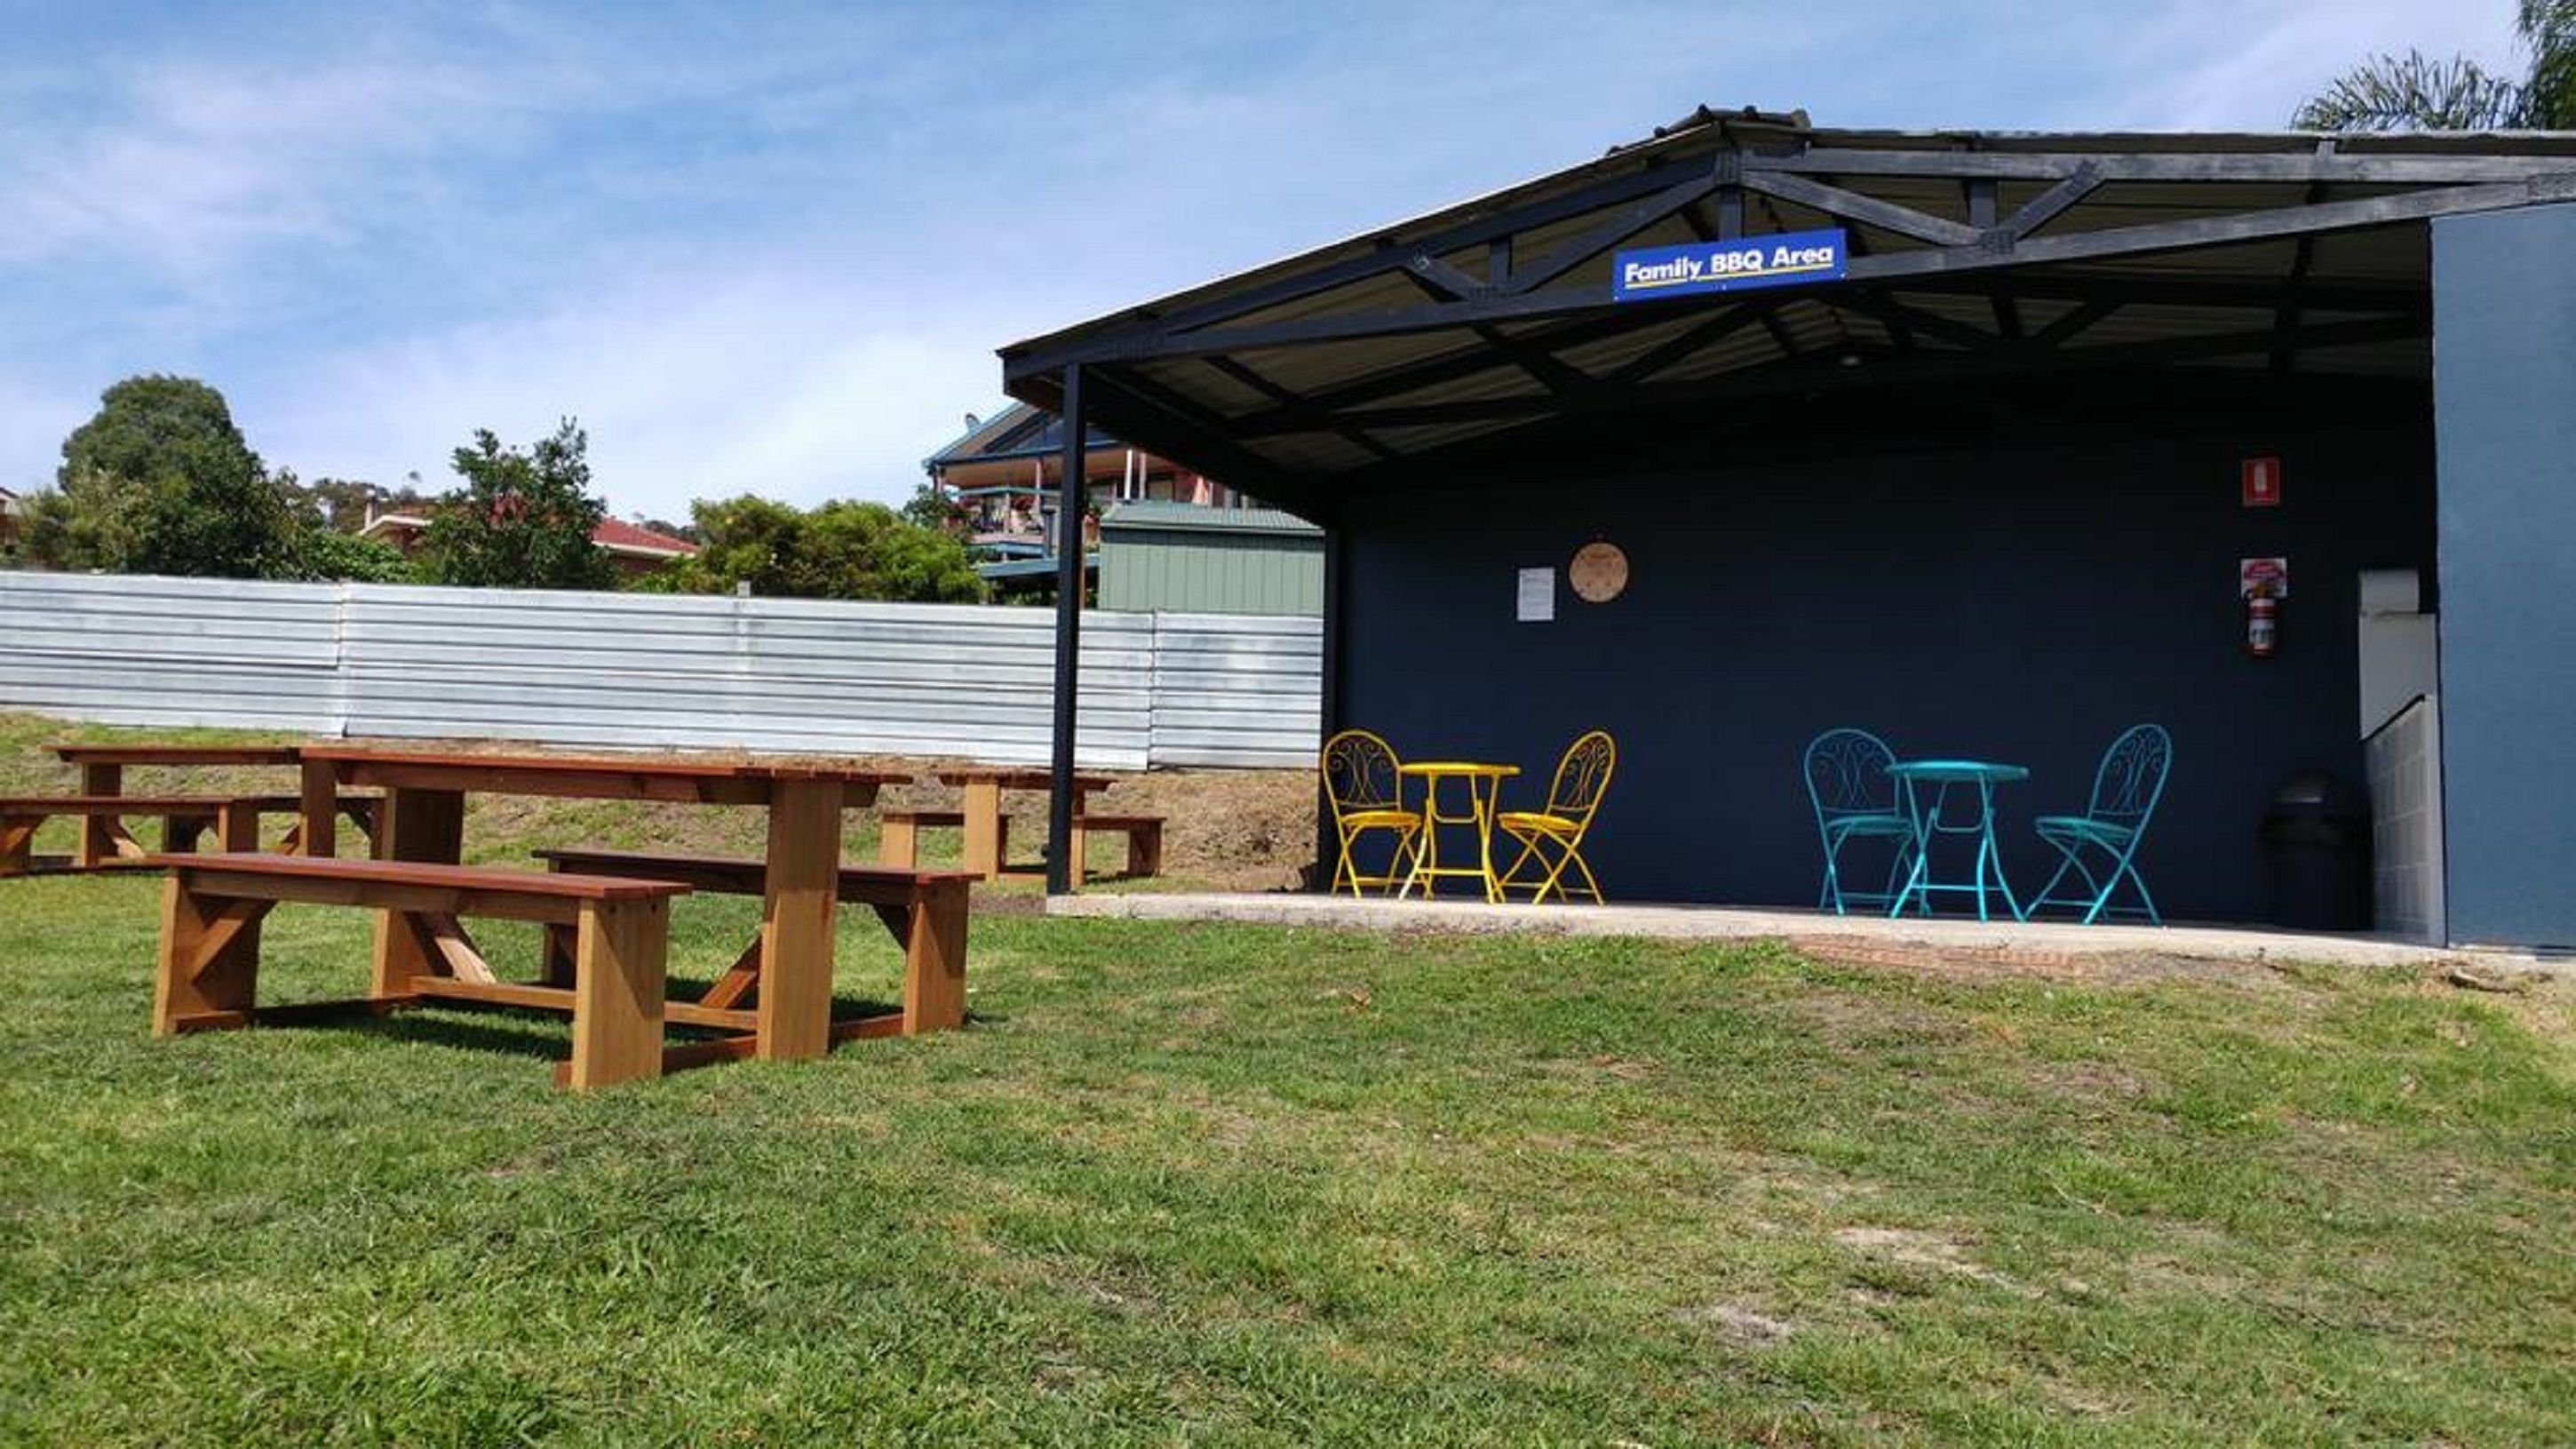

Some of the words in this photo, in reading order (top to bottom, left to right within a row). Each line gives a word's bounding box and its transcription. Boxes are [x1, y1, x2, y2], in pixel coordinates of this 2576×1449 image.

[1625, 256, 1703, 282] Family
[1711, 250, 1763, 273] BBQ
[1771, 246, 1833, 267] Area
